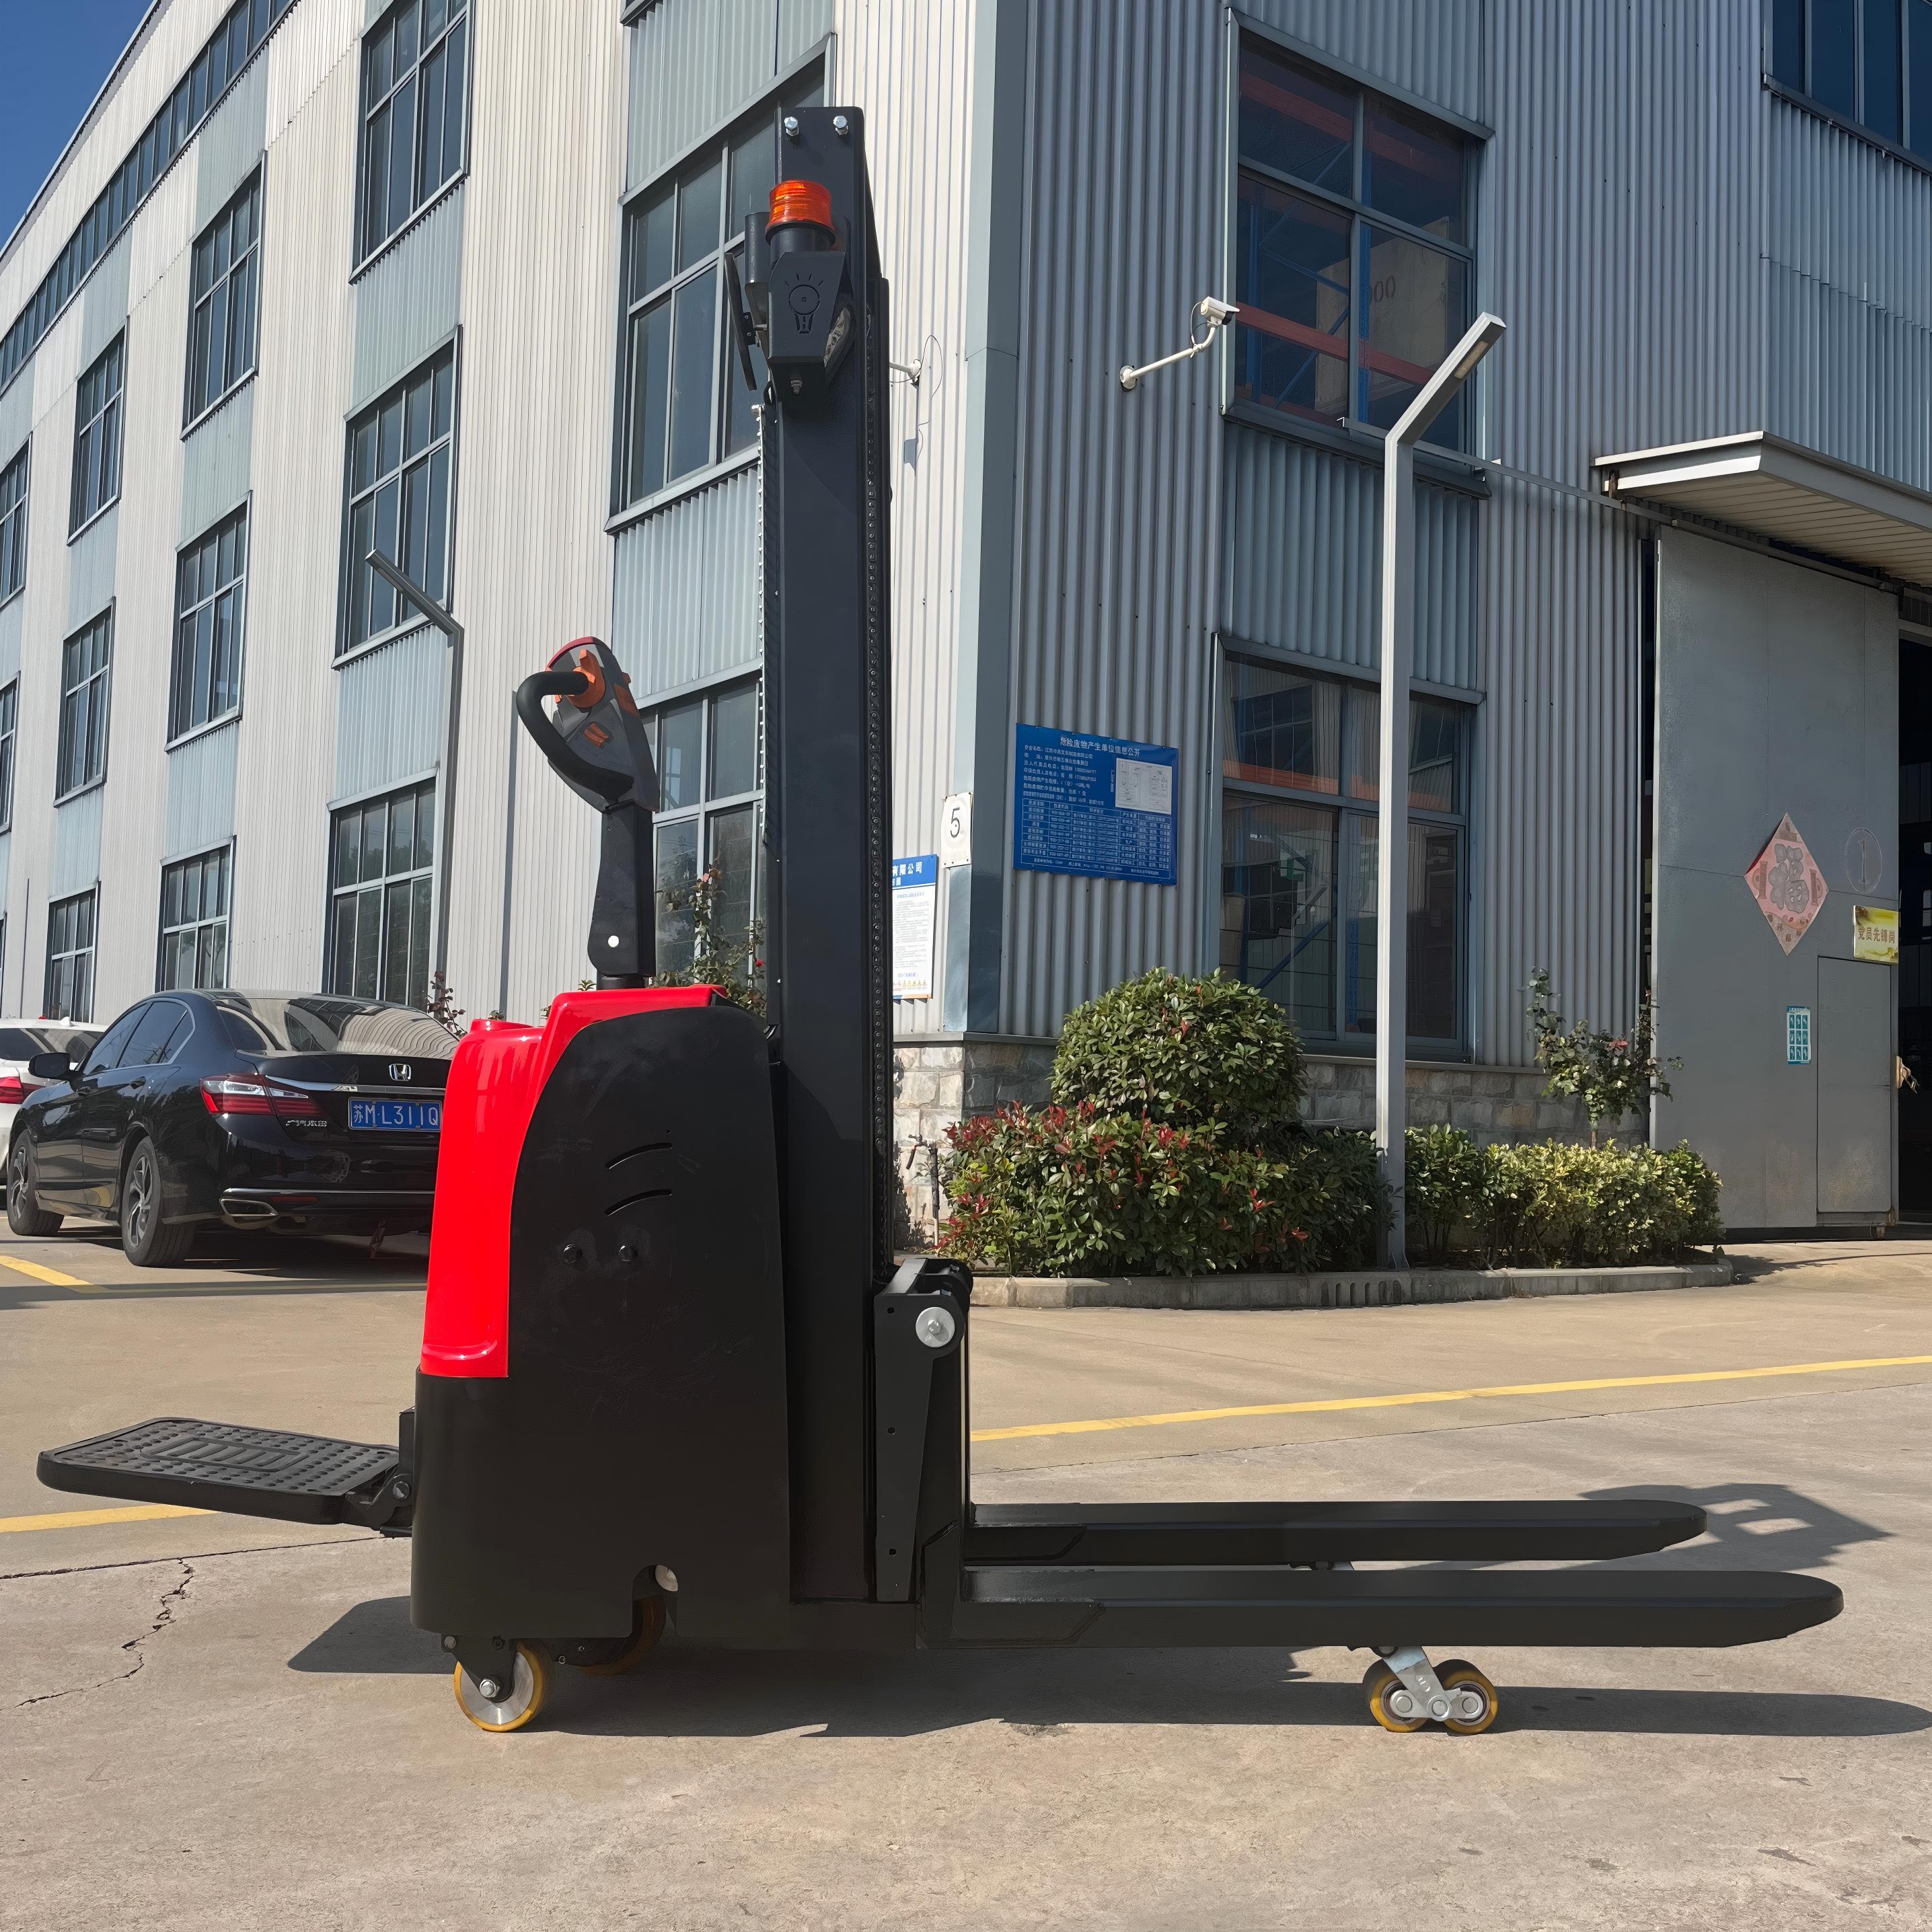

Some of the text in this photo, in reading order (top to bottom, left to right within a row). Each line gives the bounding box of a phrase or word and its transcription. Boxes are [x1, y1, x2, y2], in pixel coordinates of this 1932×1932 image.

[950, 807, 961, 838] 5
[893, 862, 922, 877] 有限公司
[1768, 843, 1810, 914] 福
